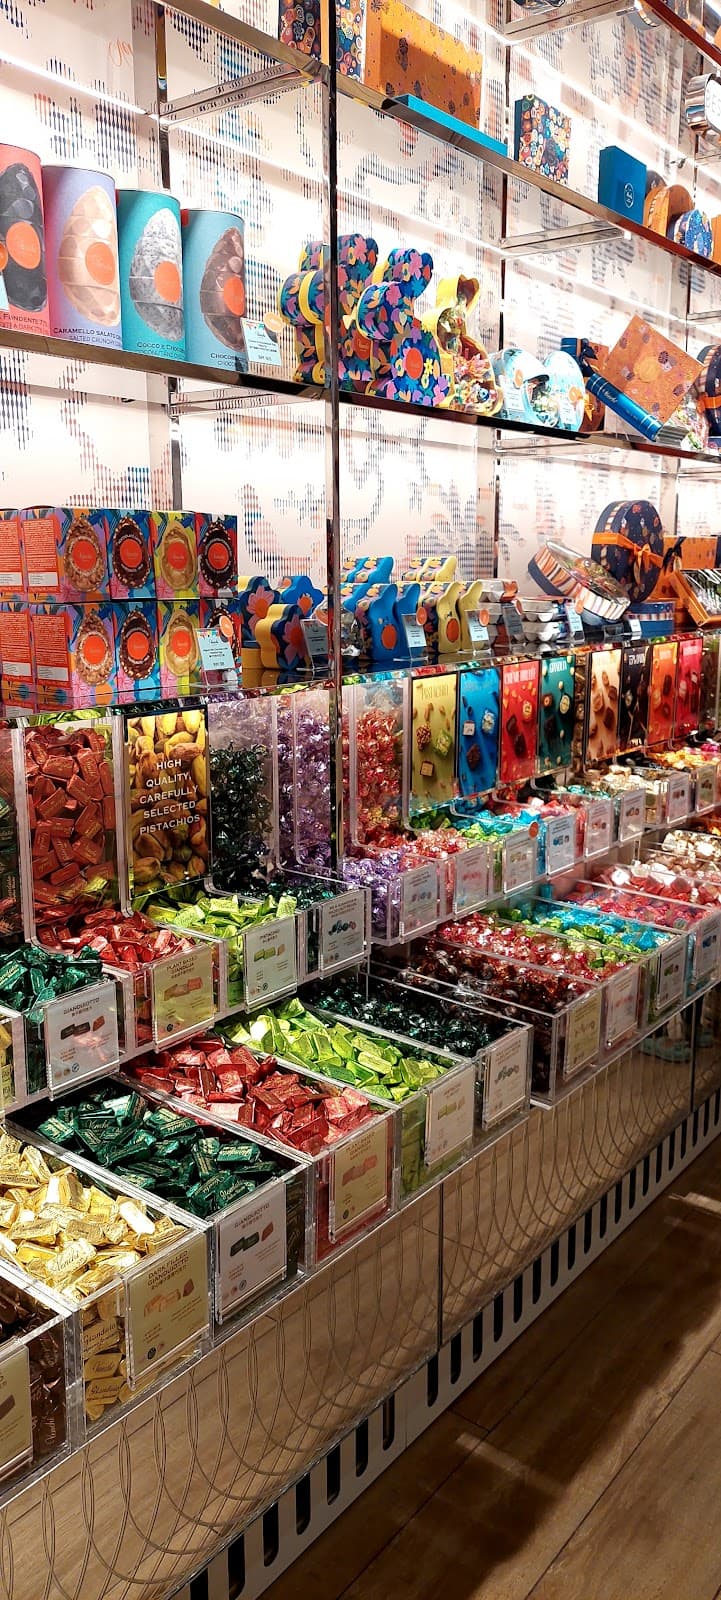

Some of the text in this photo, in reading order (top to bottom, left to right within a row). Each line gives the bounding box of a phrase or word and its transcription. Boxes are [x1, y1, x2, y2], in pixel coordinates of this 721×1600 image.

[53, 327, 95, 336] CARAMELLO
[156, 759, 182, 771] HIGH
[146, 772, 192, 788] QUALITY,
[140, 785, 198, 804] CAREFULLY
[143, 801, 196, 819] SELECTED
[140, 814, 200, 835] PISTACHIOS
